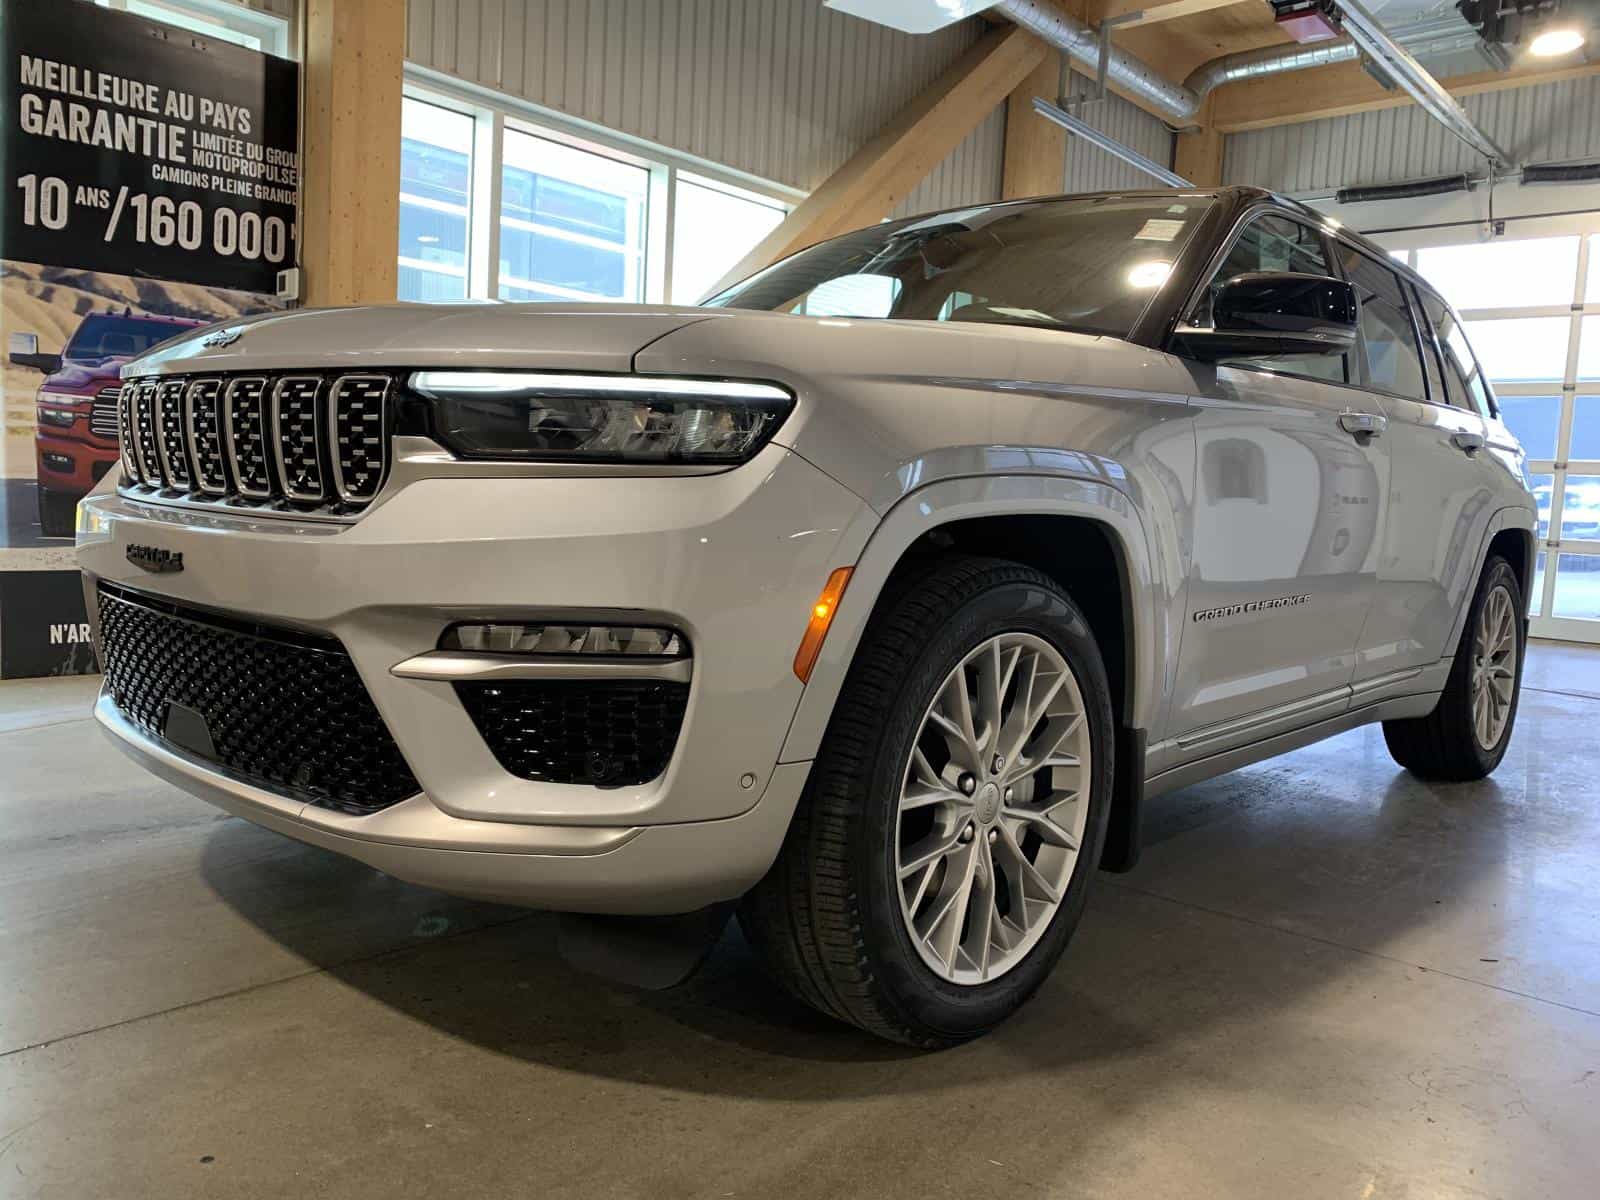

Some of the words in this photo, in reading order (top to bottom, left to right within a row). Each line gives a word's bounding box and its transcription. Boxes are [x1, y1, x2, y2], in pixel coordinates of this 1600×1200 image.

[20, 54, 160, 114] MEILLEURE
[164, 89, 194, 121] AU
[199, 97, 251, 135] PAYS
[20, 93, 186, 163] GARANTIE
[192, 129, 243, 157] LIMITÉE
[246, 141, 264, 161] DU
[151, 163, 209, 189] CAMIONS
[211, 175, 253, 198] PLEINE
[17, 173, 69, 230] 10
[75, 185, 110, 209] ANS
[213, 207, 286, 263] 000
[1193, 605, 1242, 622] GRAND
[1244, 594, 1312, 612] CHEROKEE
[50, 623, 94, 644] N'AR
